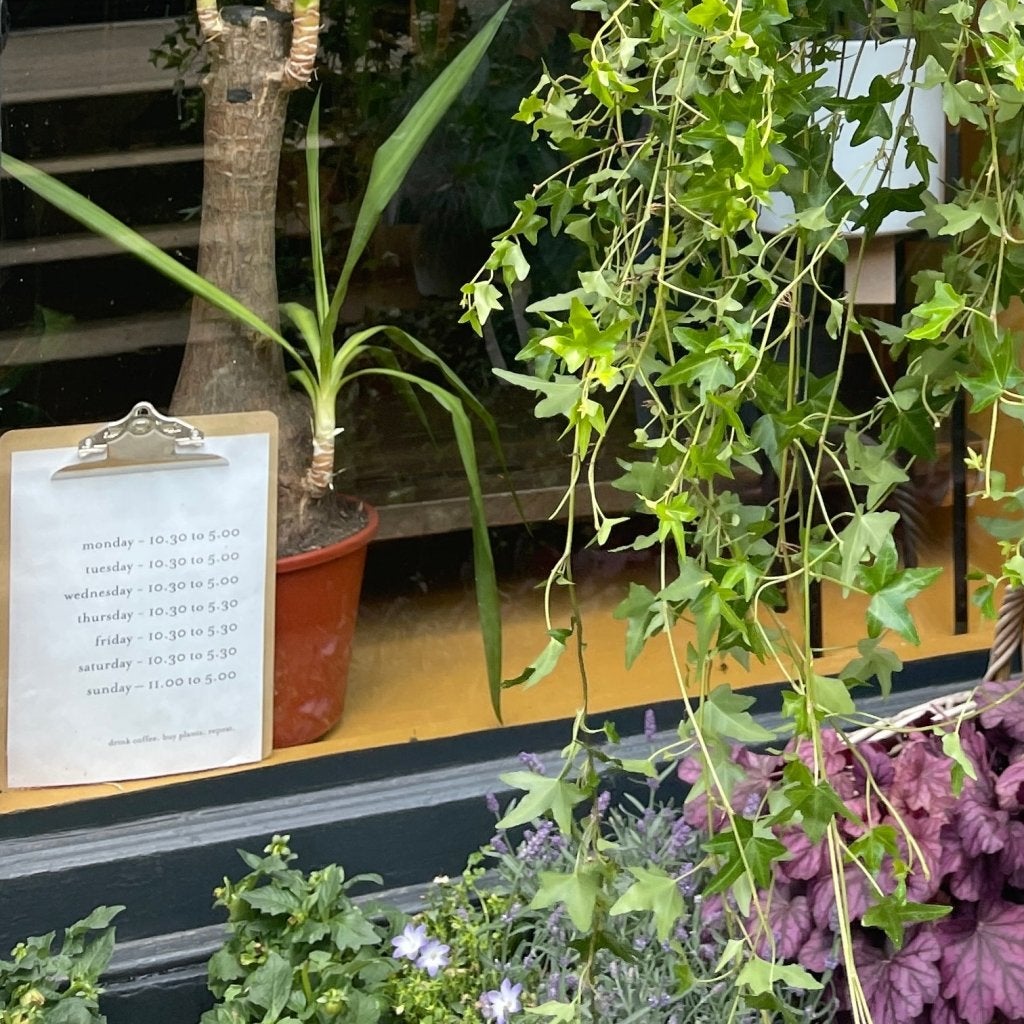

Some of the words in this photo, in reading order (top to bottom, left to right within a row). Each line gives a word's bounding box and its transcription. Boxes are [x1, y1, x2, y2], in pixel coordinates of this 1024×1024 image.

[82, 536, 134, 551] monday
[150, 533, 187, 545] 10.30
[192, 533, 204, 541] to
[208, 528, 240, 542] 5.00
[86, 561, 133, 574] tuesday
[149, 557, 186, 569] 10.30
[191, 557, 204, 565] to
[208, 552, 239, 566] 5.00
[64, 585, 133, 600] wednesday
[149, 581, 186, 593] 10.30
[190, 580, 203, 589] to
[207, 576, 239, 589] 5.00
[78, 610, 134, 624] thursday
[149, 605, 187, 617] 10.30
[191, 604, 204, 613] to
[208, 599, 238, 613] 5.30
[95, 634, 133, 647] friday
[149, 629, 186, 641] 10.30
[191, 628, 203, 636] to
[208, 623, 238, 637] 5.30
[78, 658, 133, 673] saturday
[148, 653, 186, 666] 10.30
[190, 653, 203, 661] to
[207, 647, 237, 661] 5.30
[86, 682, 132, 696] sunday
[149, 677, 184, 690] 11.00
[188, 677, 201, 685] to
[205, 671, 236, 685] 5.00
[162, 733, 176, 742] buy
